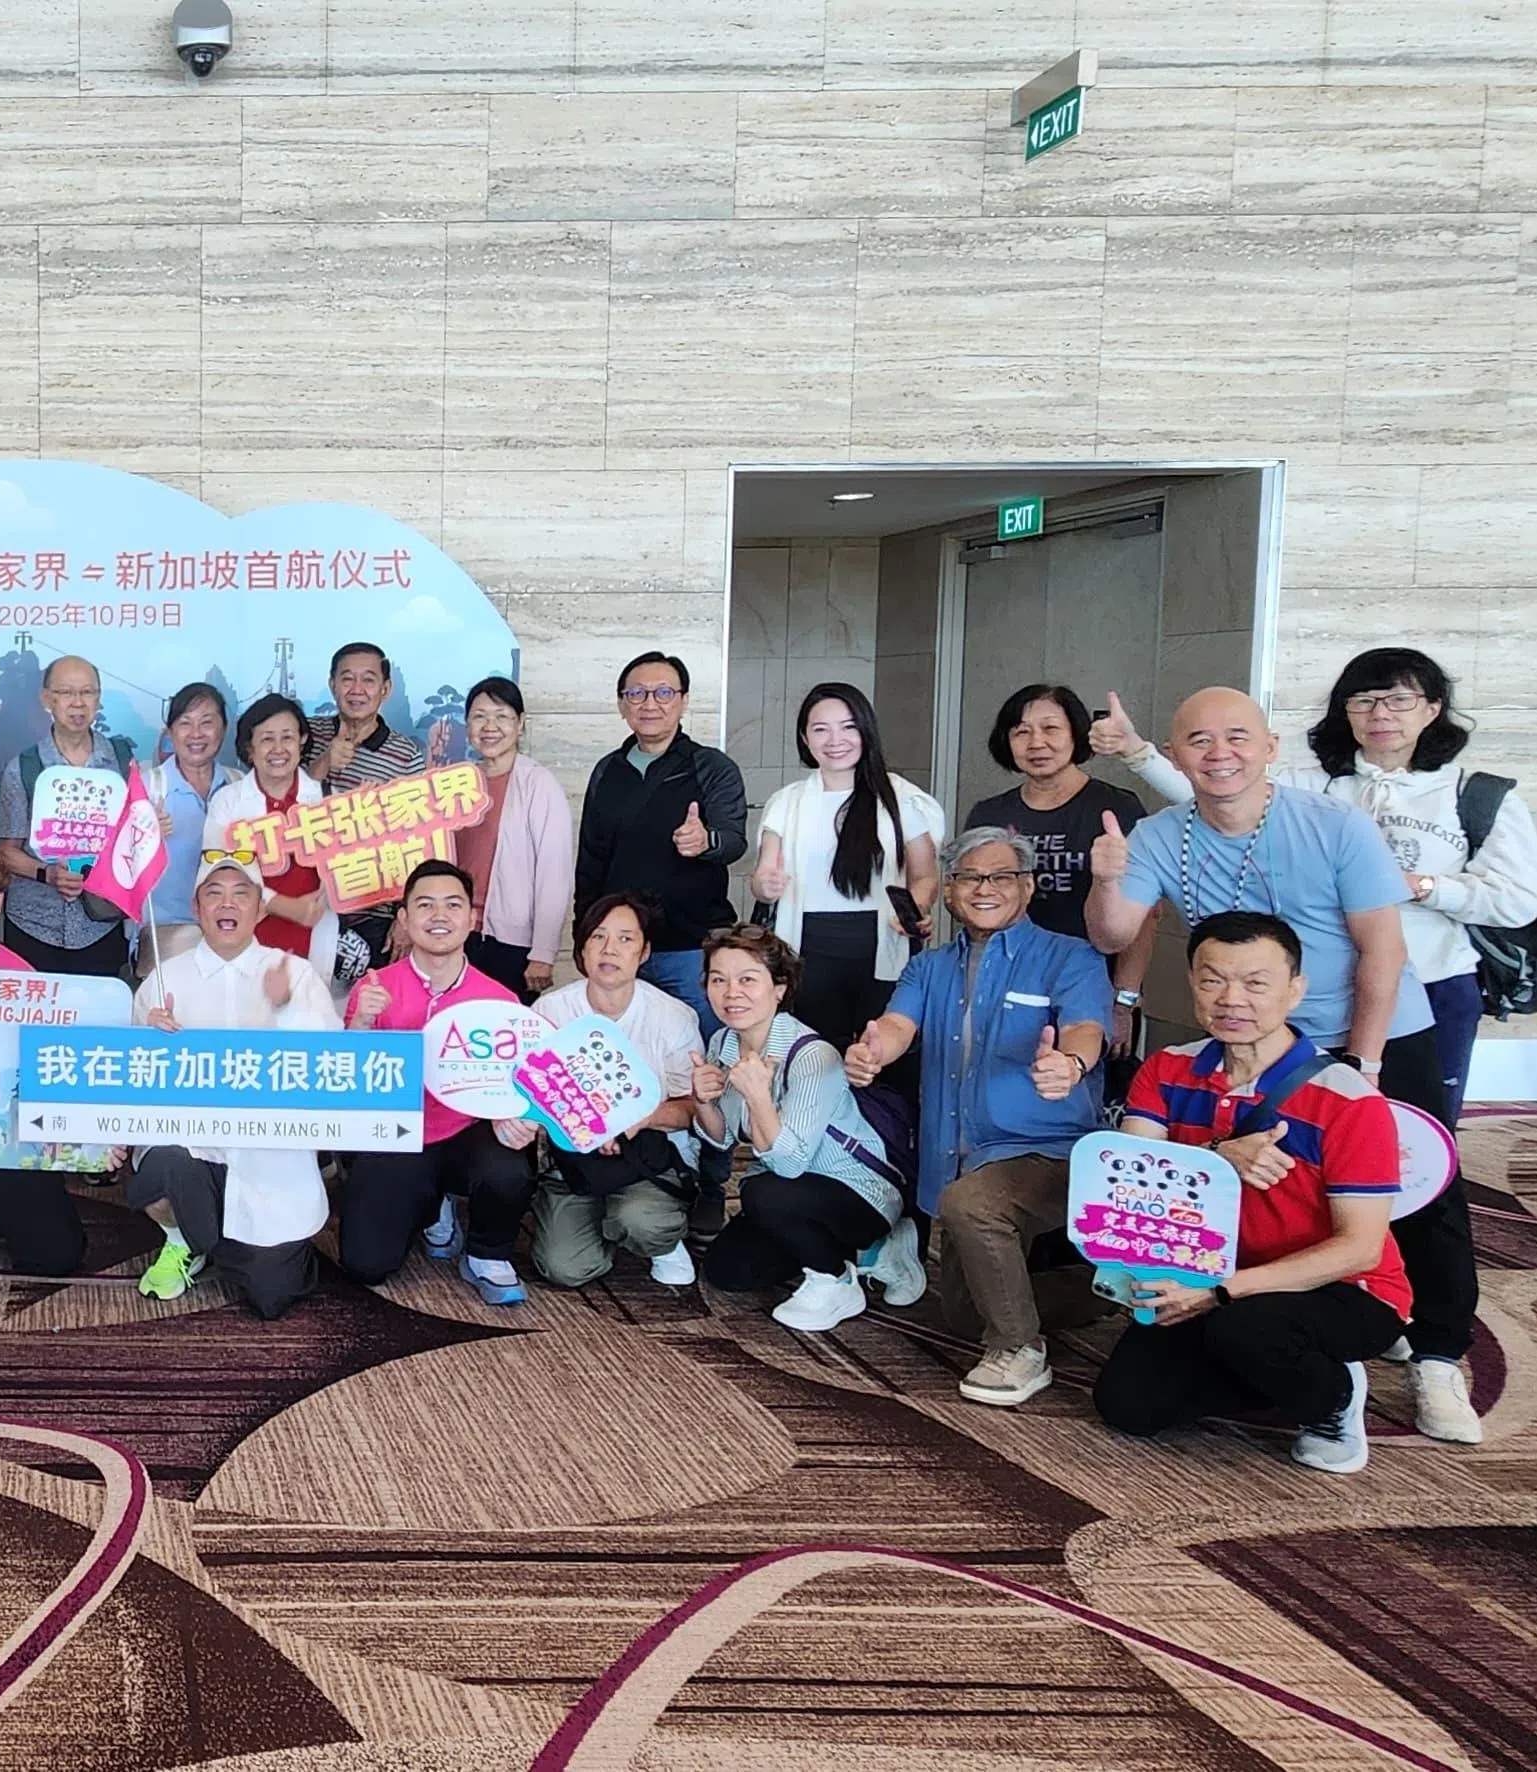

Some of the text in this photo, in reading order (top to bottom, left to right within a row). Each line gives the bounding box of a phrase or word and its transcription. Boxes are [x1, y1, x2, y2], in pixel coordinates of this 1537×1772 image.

[1039, 98, 1077, 149] EXIT
[1005, 504, 1035, 533] EXIT
[115, 549, 411, 591] 新加坡首航仪式
[60, 811, 87, 821] HAO
[233, 765, 484, 864] 打卡张家界
[1034, 852, 1084, 871] RTH
[1037, 873, 1072, 892] CE
[439, 1020, 518, 1059] Asa
[37, 1044, 405, 1093] 我在新加坡很想你
[438, 1063, 511, 1071] HOLIDAY
[567, 1060, 594, 1092] HAO
[52, 1116, 67, 1131] 南
[97, 1117, 341, 1137] WO ZAI XIN JIA PO HEN XIANG NI
[372, 1123, 388, 1138] 北
[1115, 1185, 1164, 1203] DAJIA
[1115, 1197, 1165, 1217] HAO
